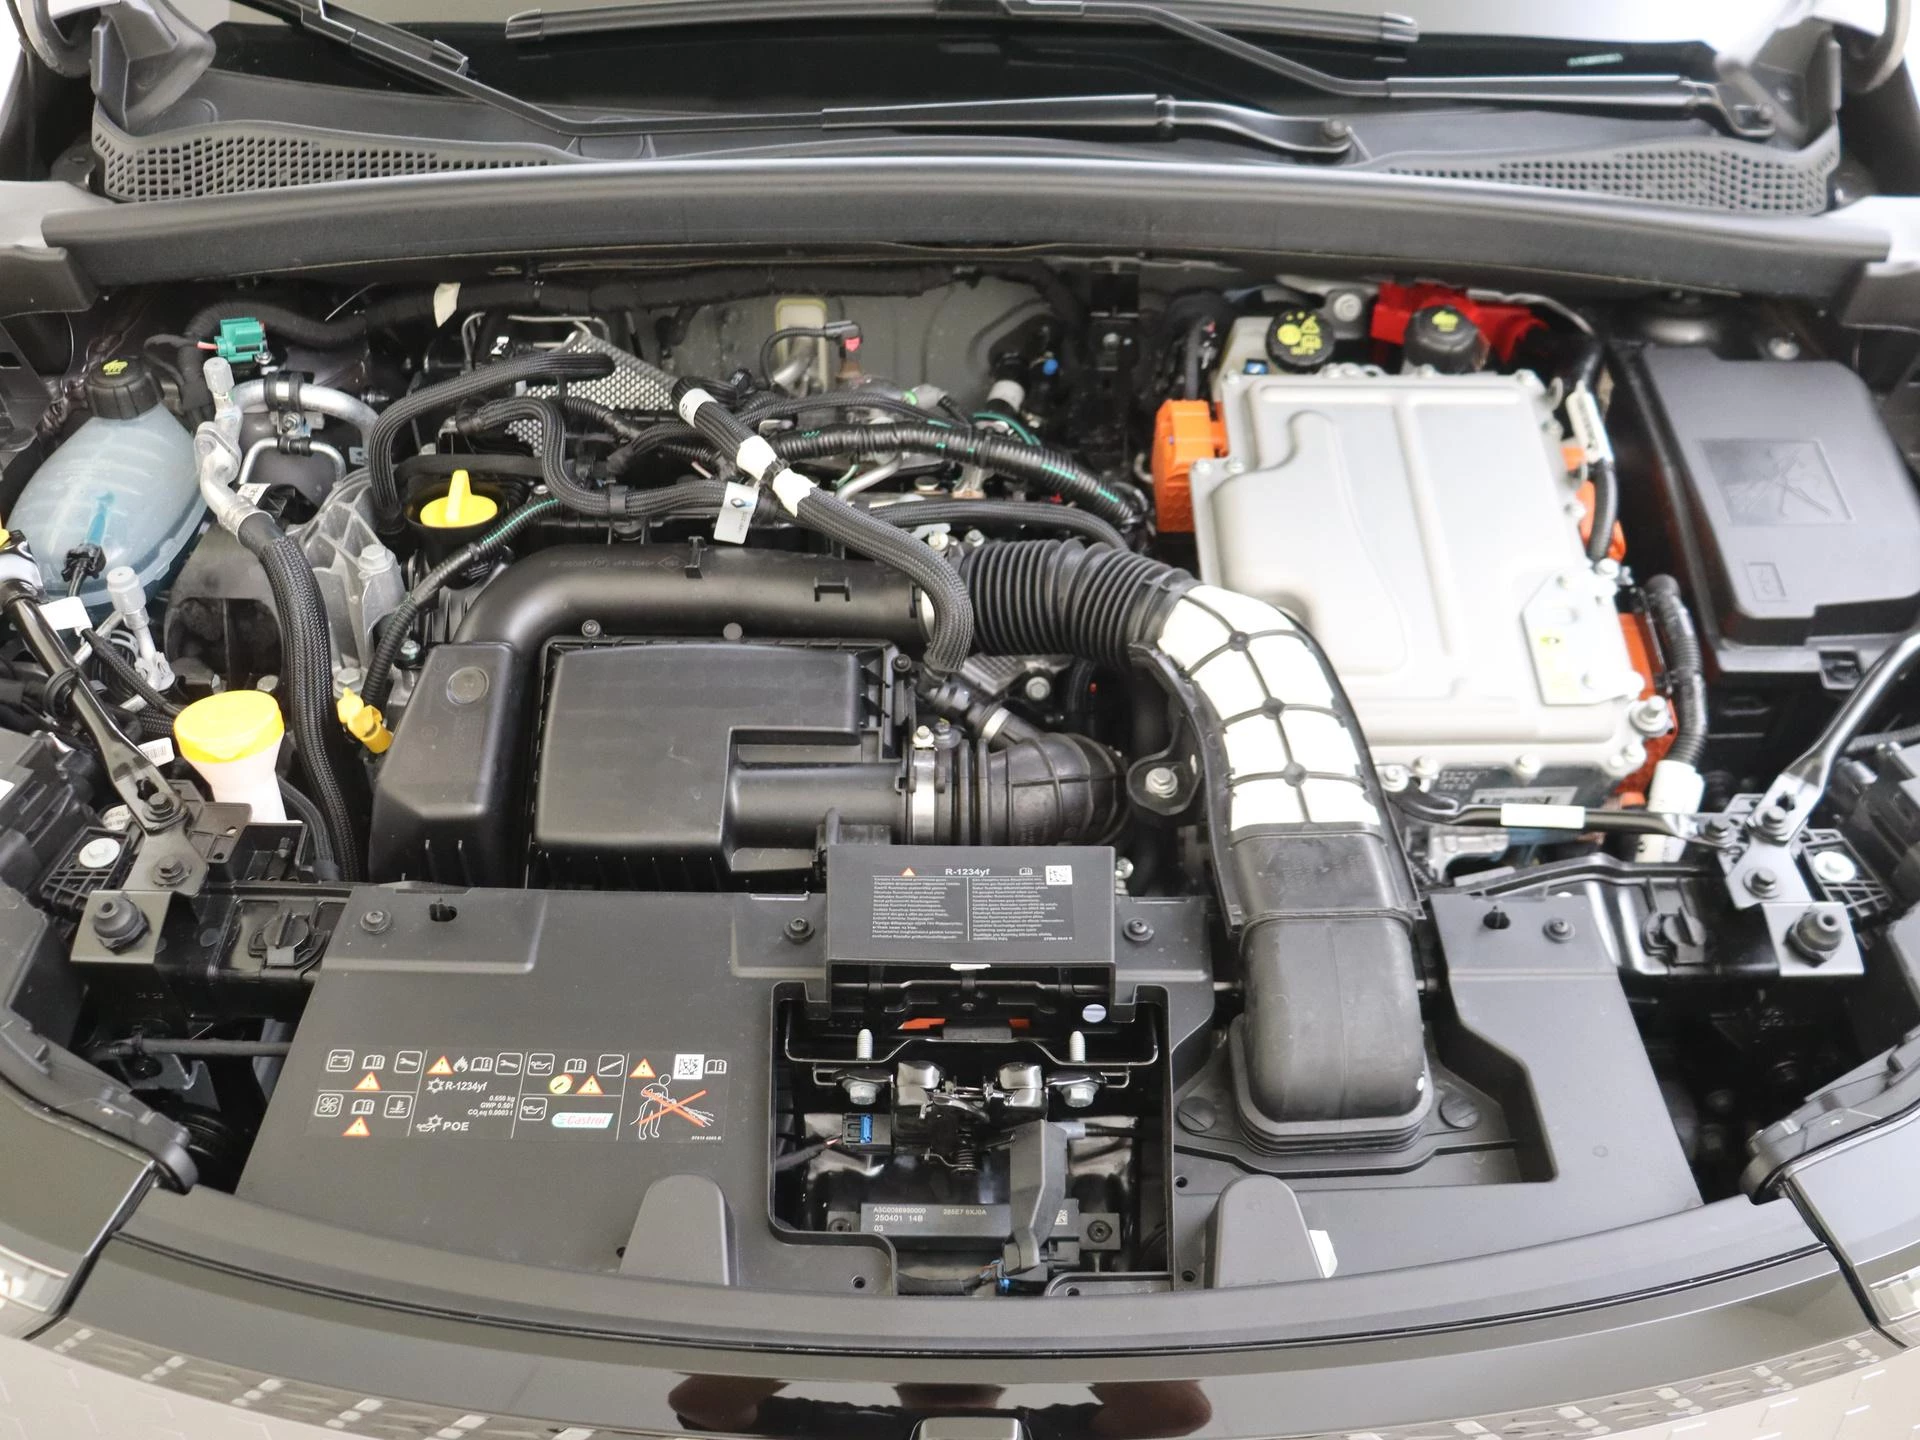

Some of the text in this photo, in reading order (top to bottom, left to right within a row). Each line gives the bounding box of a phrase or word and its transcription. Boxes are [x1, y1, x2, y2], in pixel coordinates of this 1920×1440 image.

[945, 868, 990, 877] R-1234yf
[445, 1081, 488, 1093] R-1234yf
[567, 1115, 607, 1126] Castrol
[442, 1121, 470, 1132] POE
[874, 1214, 903, 1222] 250401
[873, 1224, 884, 1232] 03
